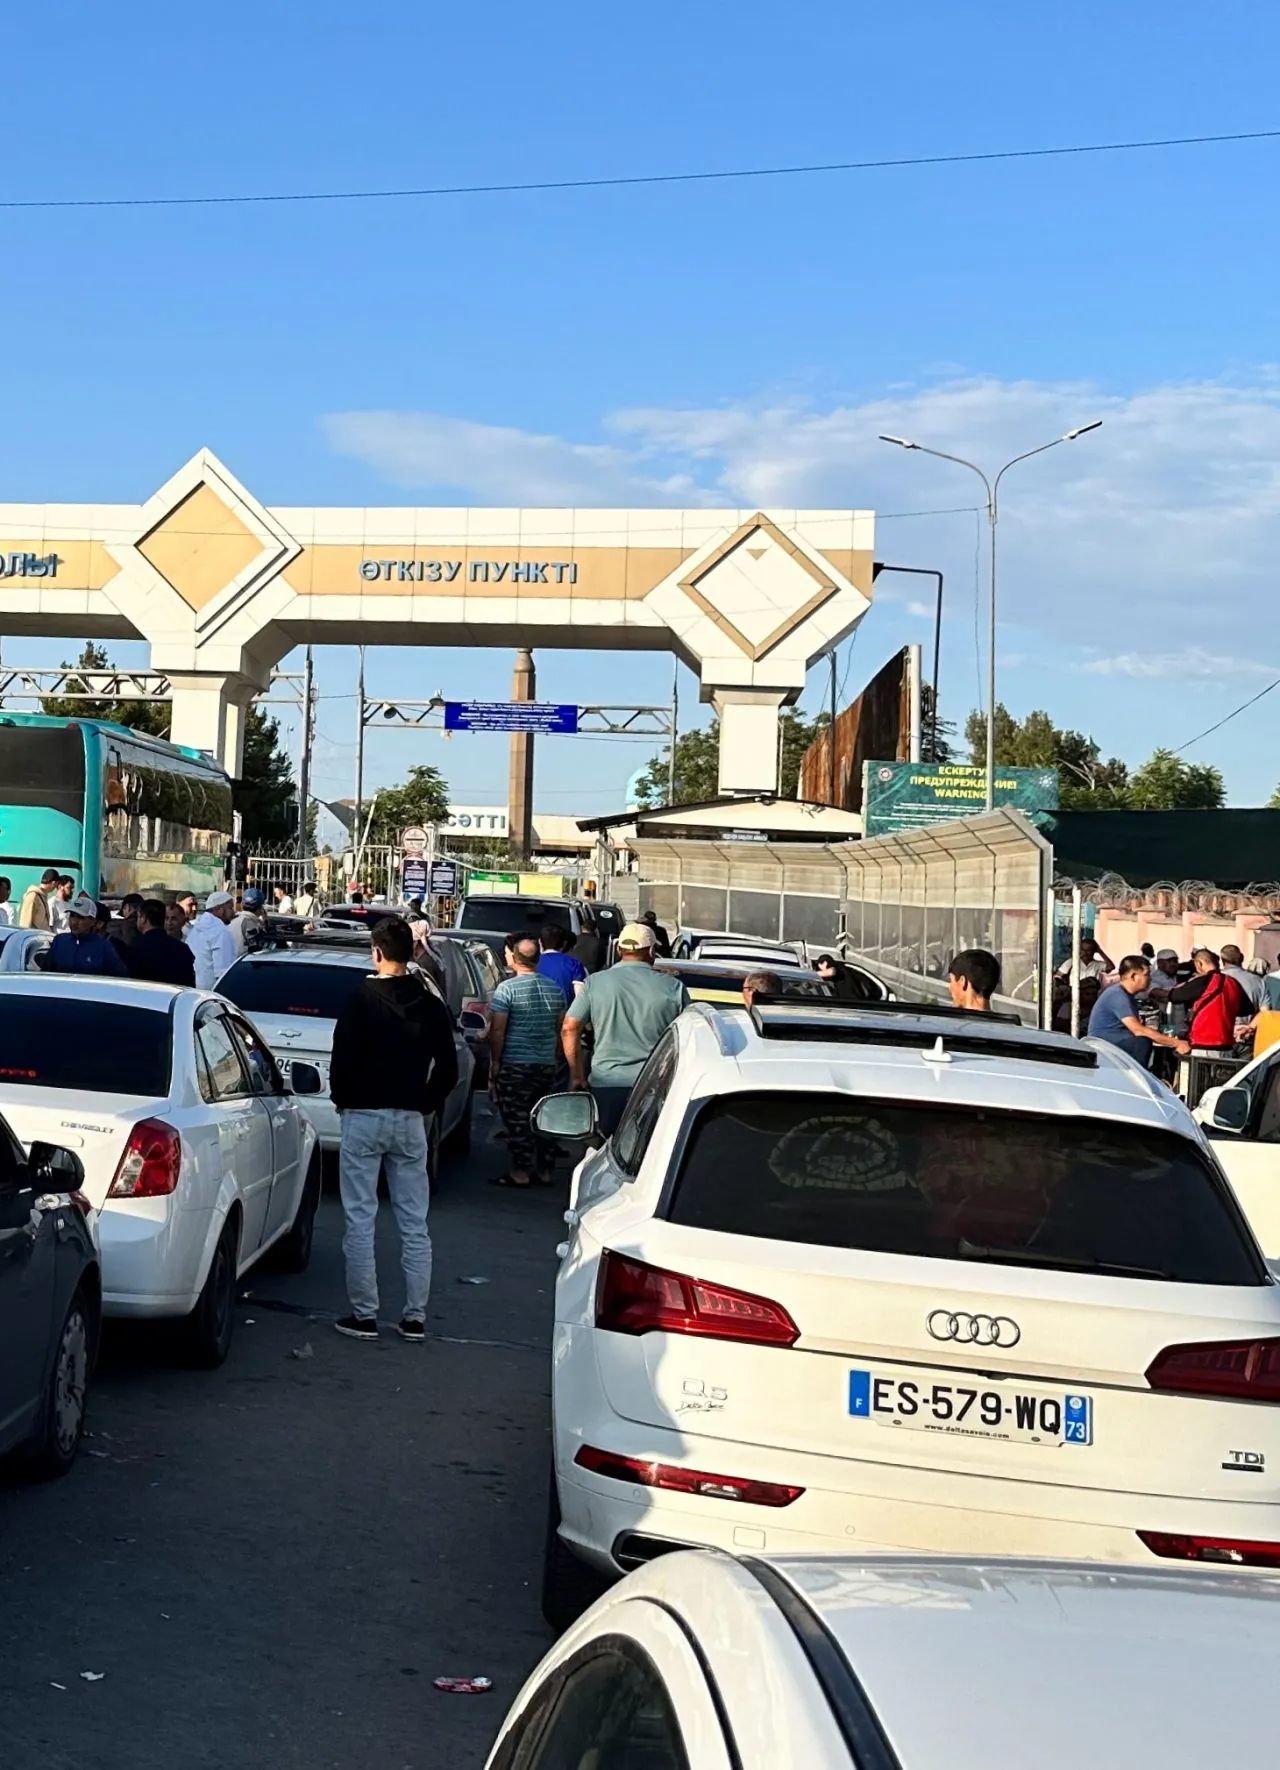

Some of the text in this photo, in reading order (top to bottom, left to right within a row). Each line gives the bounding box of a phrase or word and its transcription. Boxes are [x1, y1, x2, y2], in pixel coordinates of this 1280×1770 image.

[359, 560, 578, 584] ӨТКІЗУ ПУНКТІ
[910, 775, 1017, 790] ПРЕДУПРЕЖДНИЕ!
[447, 813, 506, 829] СӘТТІ
[681, 1377, 728, 1401] Q5
[855, 1397, 863, 1408] F
[873, 1378, 1061, 1435] ES-579-WQ
[1066, 1421, 1086, 1439] 73
[1229, 1450, 1265, 1464] TDI
